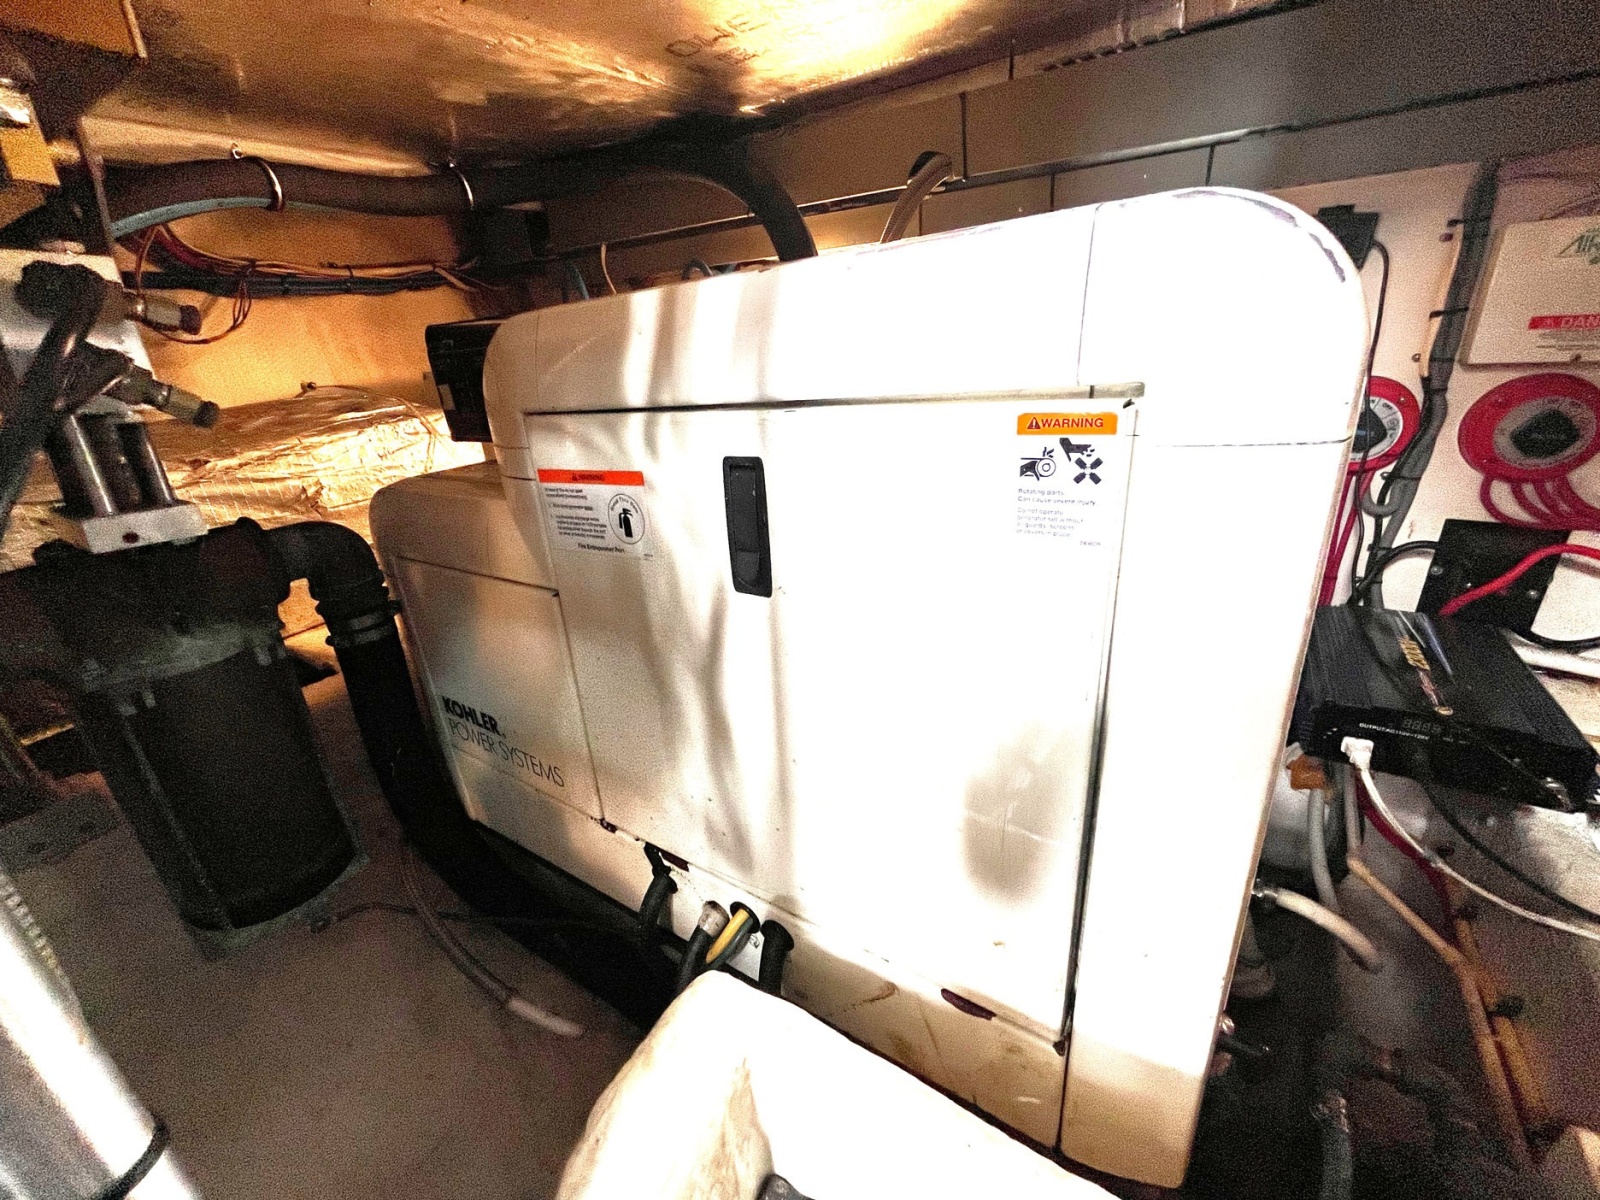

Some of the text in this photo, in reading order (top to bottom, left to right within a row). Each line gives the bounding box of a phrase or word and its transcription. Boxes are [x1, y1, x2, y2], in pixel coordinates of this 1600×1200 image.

[1041, 418, 1104, 428] WARNING
[1017, 488, 1045, 496] Rotating
[442, 695, 502, 736] KOHLER
[449, 718, 565, 788] POWER SYSTEMS
